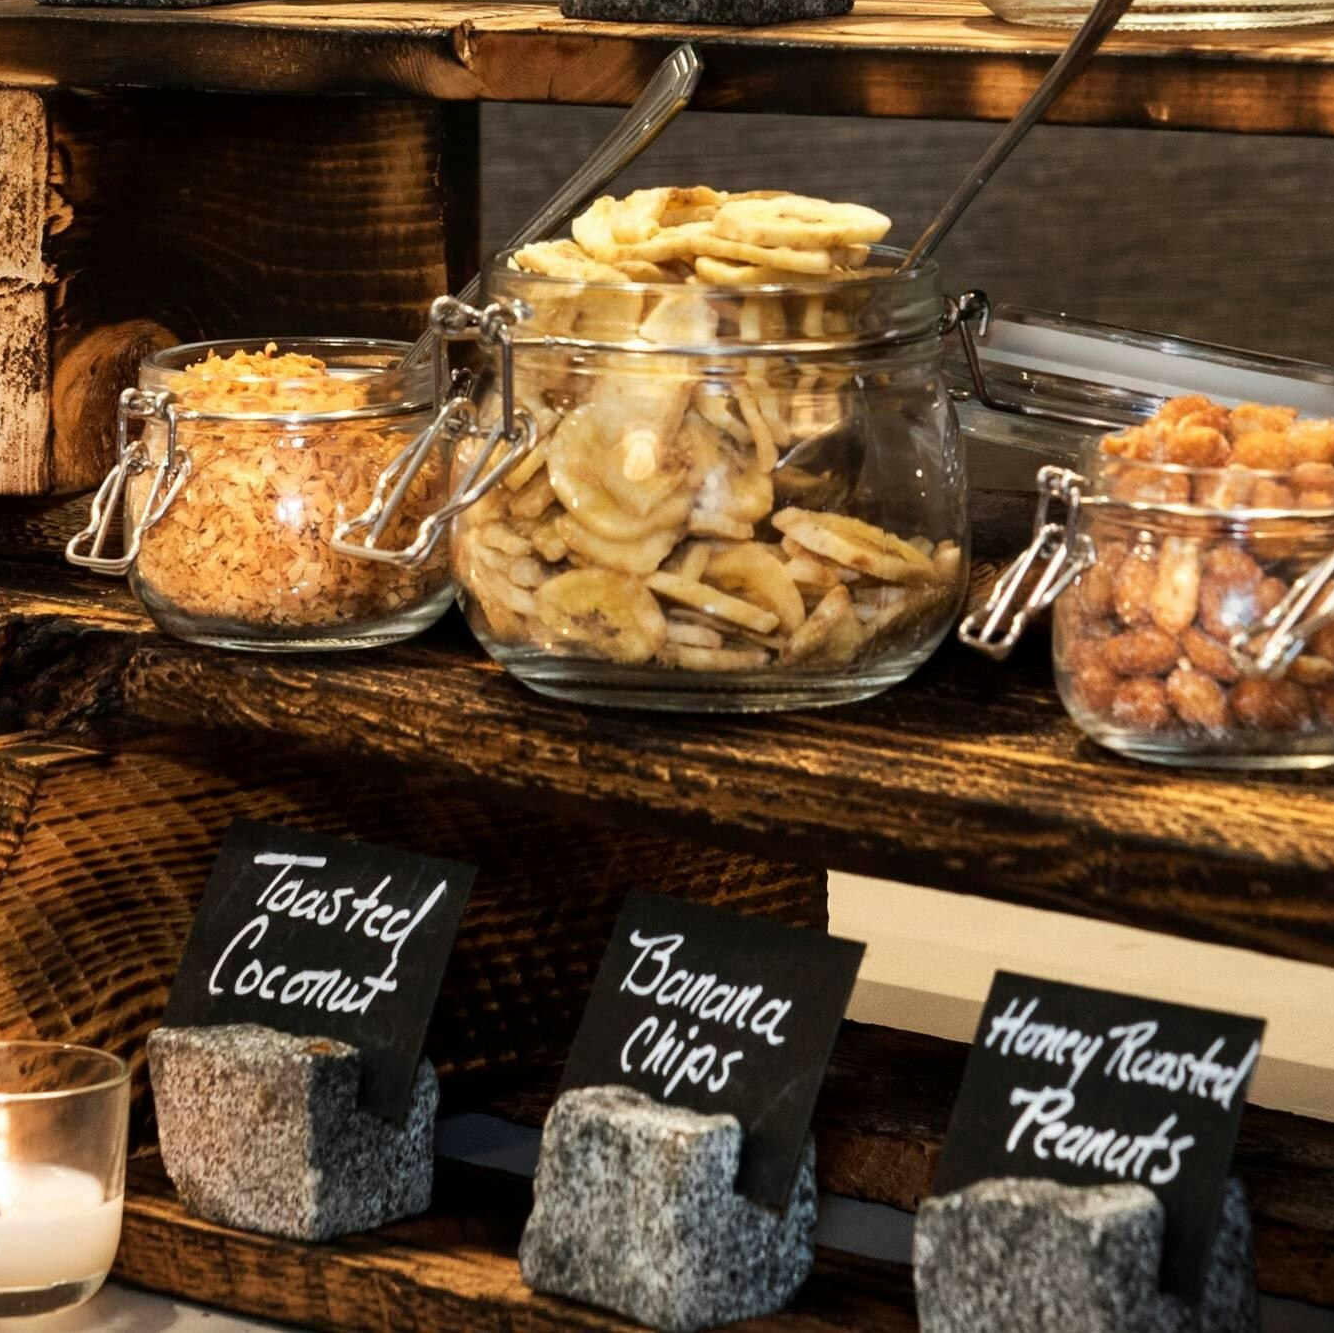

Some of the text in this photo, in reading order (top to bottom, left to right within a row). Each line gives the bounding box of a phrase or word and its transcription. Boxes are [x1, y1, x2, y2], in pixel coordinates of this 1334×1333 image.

[254, 852, 447, 960] Toasted
[208, 914, 398, 1016] Coconut
[619, 928, 793, 1046] Banana
[619, 1016, 744, 1098] Chips
[984, 997, 1261, 1111] Honey Roasted
[1005, 1086, 1196, 1185] Peanuts
